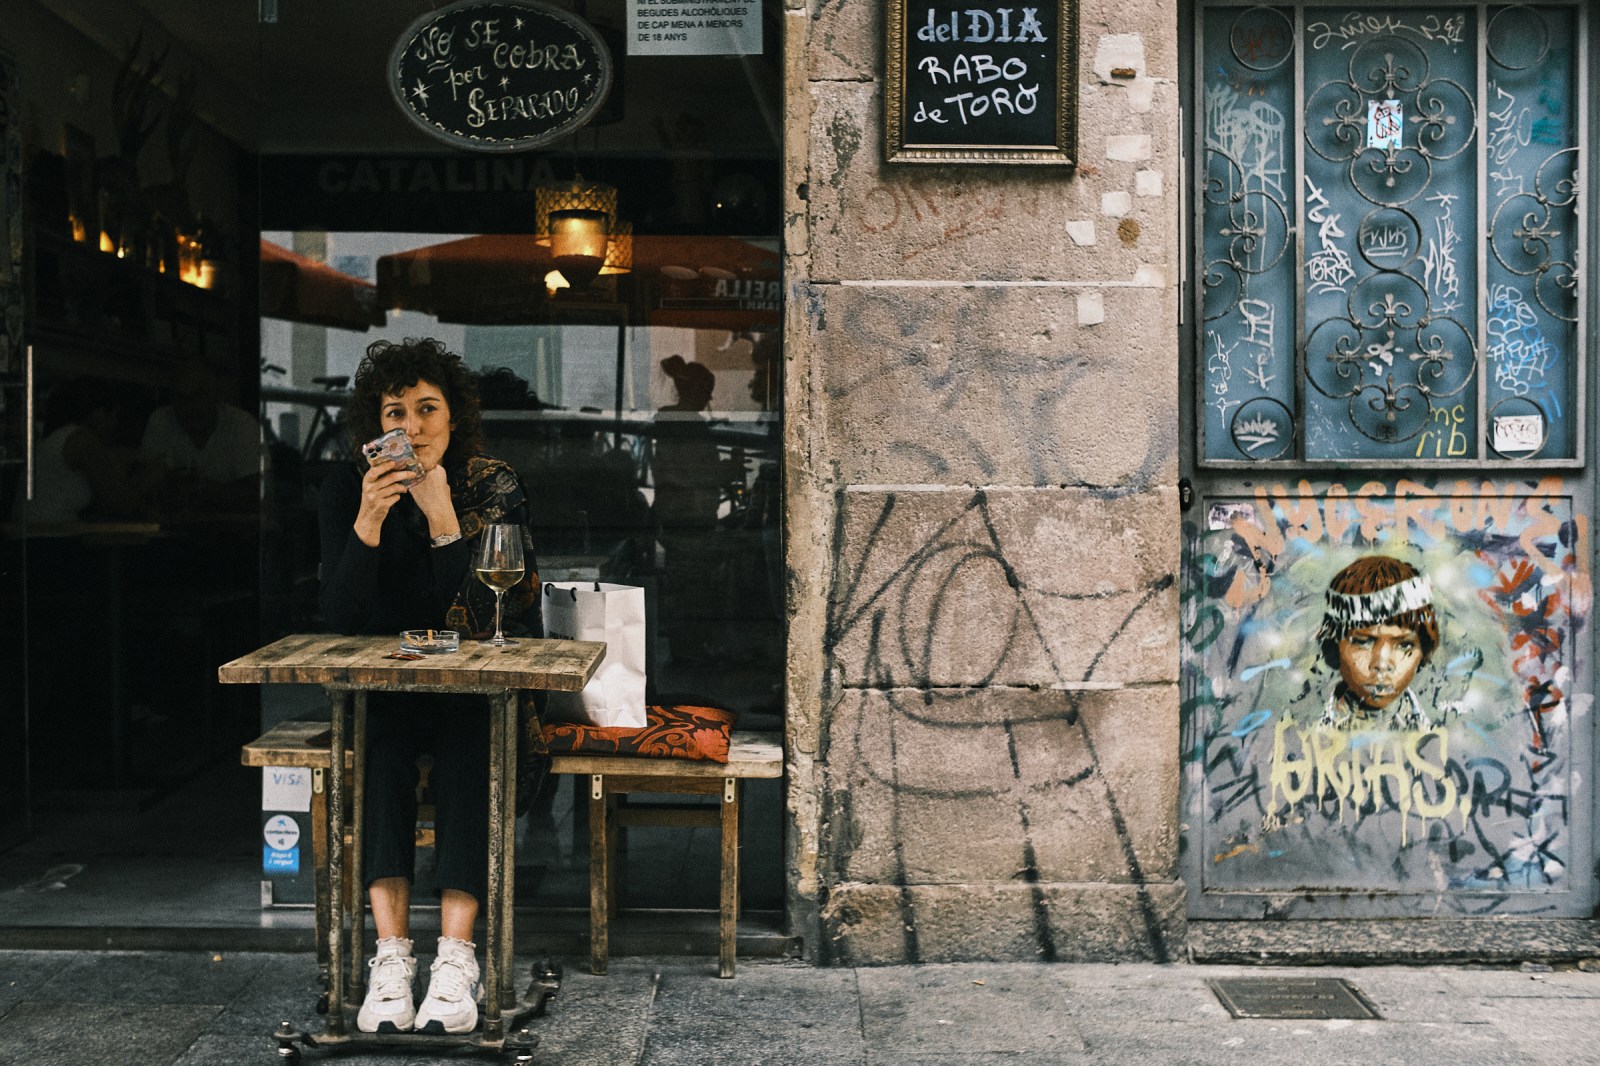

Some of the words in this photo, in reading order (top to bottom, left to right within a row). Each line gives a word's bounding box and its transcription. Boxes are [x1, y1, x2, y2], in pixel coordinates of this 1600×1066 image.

[637, 8, 679, 17] BEGUDES
[681, 7, 748, 16] ALCOHÒLIQUES
[638, 21, 650, 29] DE
[652, 21, 669, 29] CAP
[671, 20, 696, 29] MENA
[698, 20, 705, 28] A
[706, 19, 743, 28] MENORS
[917, 8, 959, 42] del
[963, 7, 1048, 43] DIA
[466, 19, 500, 48] SE
[638, 33, 650, 41] DE
[652, 33, 662, 41] 18
[664, 32, 688, 41] ANYS
[444, 66, 489, 101] por
[918, 53, 1028, 85] RABO
[913, 101, 949, 124] de
[943, 83, 1040, 125] TORO
[318, 158, 558, 193] CATALINA
[1415, 421, 1467, 457] rib
[273, 773, 304, 786] VISA
